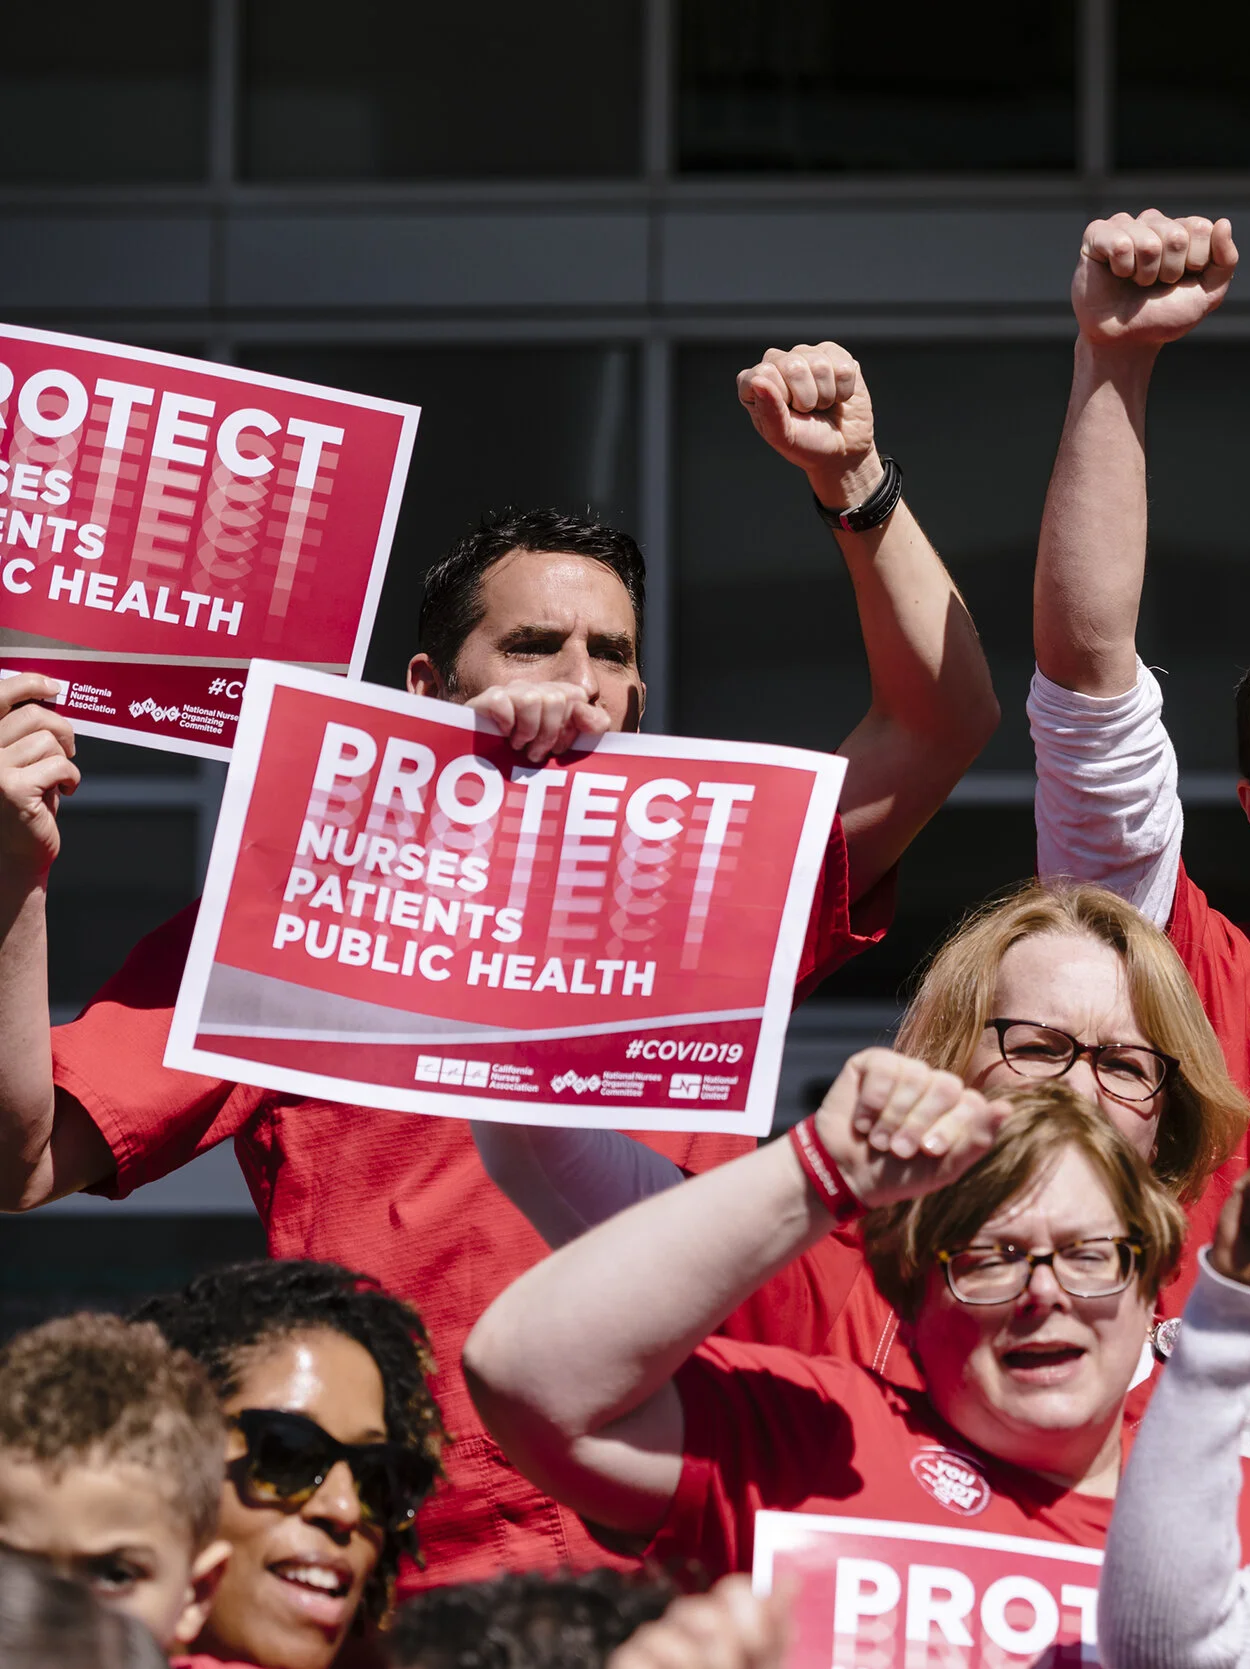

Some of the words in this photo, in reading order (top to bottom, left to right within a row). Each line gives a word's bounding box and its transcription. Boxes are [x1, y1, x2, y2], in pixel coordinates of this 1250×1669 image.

[48, 565, 244, 636] HEALTH
[70, 691, 98, 703] Nurses
[72, 683, 112, 697] California
[68, 699, 116, 715] Association
[183, 704, 216, 717] National
[216, 710, 240, 721] Nurse
[179, 720, 222, 734] Committee
[181, 712, 224, 727] Organizing
[311, 721, 755, 845] PROTECT
[298, 820, 490, 893] NURSES
[283, 866, 523, 942] PATIENTS
[272, 913, 451, 981] PUBLIC
[467, 951, 657, 997] HEALTH
[625, 1039, 744, 1064] #COVID19
[491, 1063, 534, 1076] California
[603, 1070, 634, 1081] National
[490, 1072, 521, 1083] Nurses
[703, 1074, 739, 1085] National
[489, 1080, 540, 1093] Association
[833, 1557, 1099, 1655] PROT
